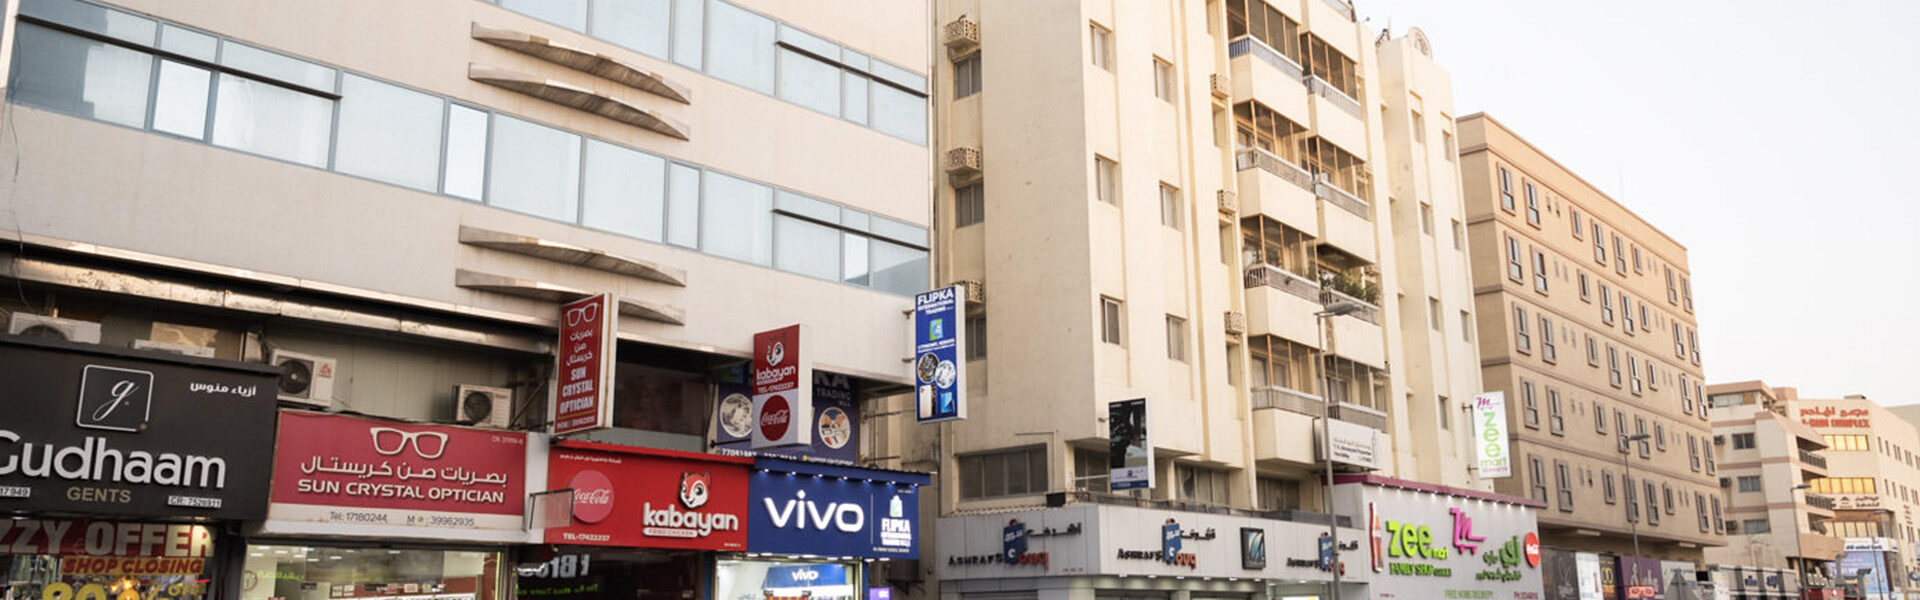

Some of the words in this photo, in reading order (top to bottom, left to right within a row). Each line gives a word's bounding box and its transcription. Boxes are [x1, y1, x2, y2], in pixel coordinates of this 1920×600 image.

[571, 366, 586, 381] SUN
[756, 365, 796, 381] kabayan
[562, 379, 593, 397] CRYSTAL
[0, 430, 226, 488] Gudhaam
[301, 456, 393, 479] كريستال
[397, 462, 436, 480] صن
[440, 467, 508, 487] بصريات
[67, 486, 132, 503] GENTS
[298, 479, 340, 494] SUN
[346, 482, 425, 499] CRYSTAL
[428, 487, 504, 504] OPTICIAN
[643, 502, 738, 537] kabayan
[764, 490, 864, 533] vivo
[84, 521, 214, 557] OFFER
[1386, 521, 1433, 558] zee
[63, 558, 118, 573] SHOP
[122, 559, 203, 574] CLOSING
[792, 569, 819, 581] vivo
